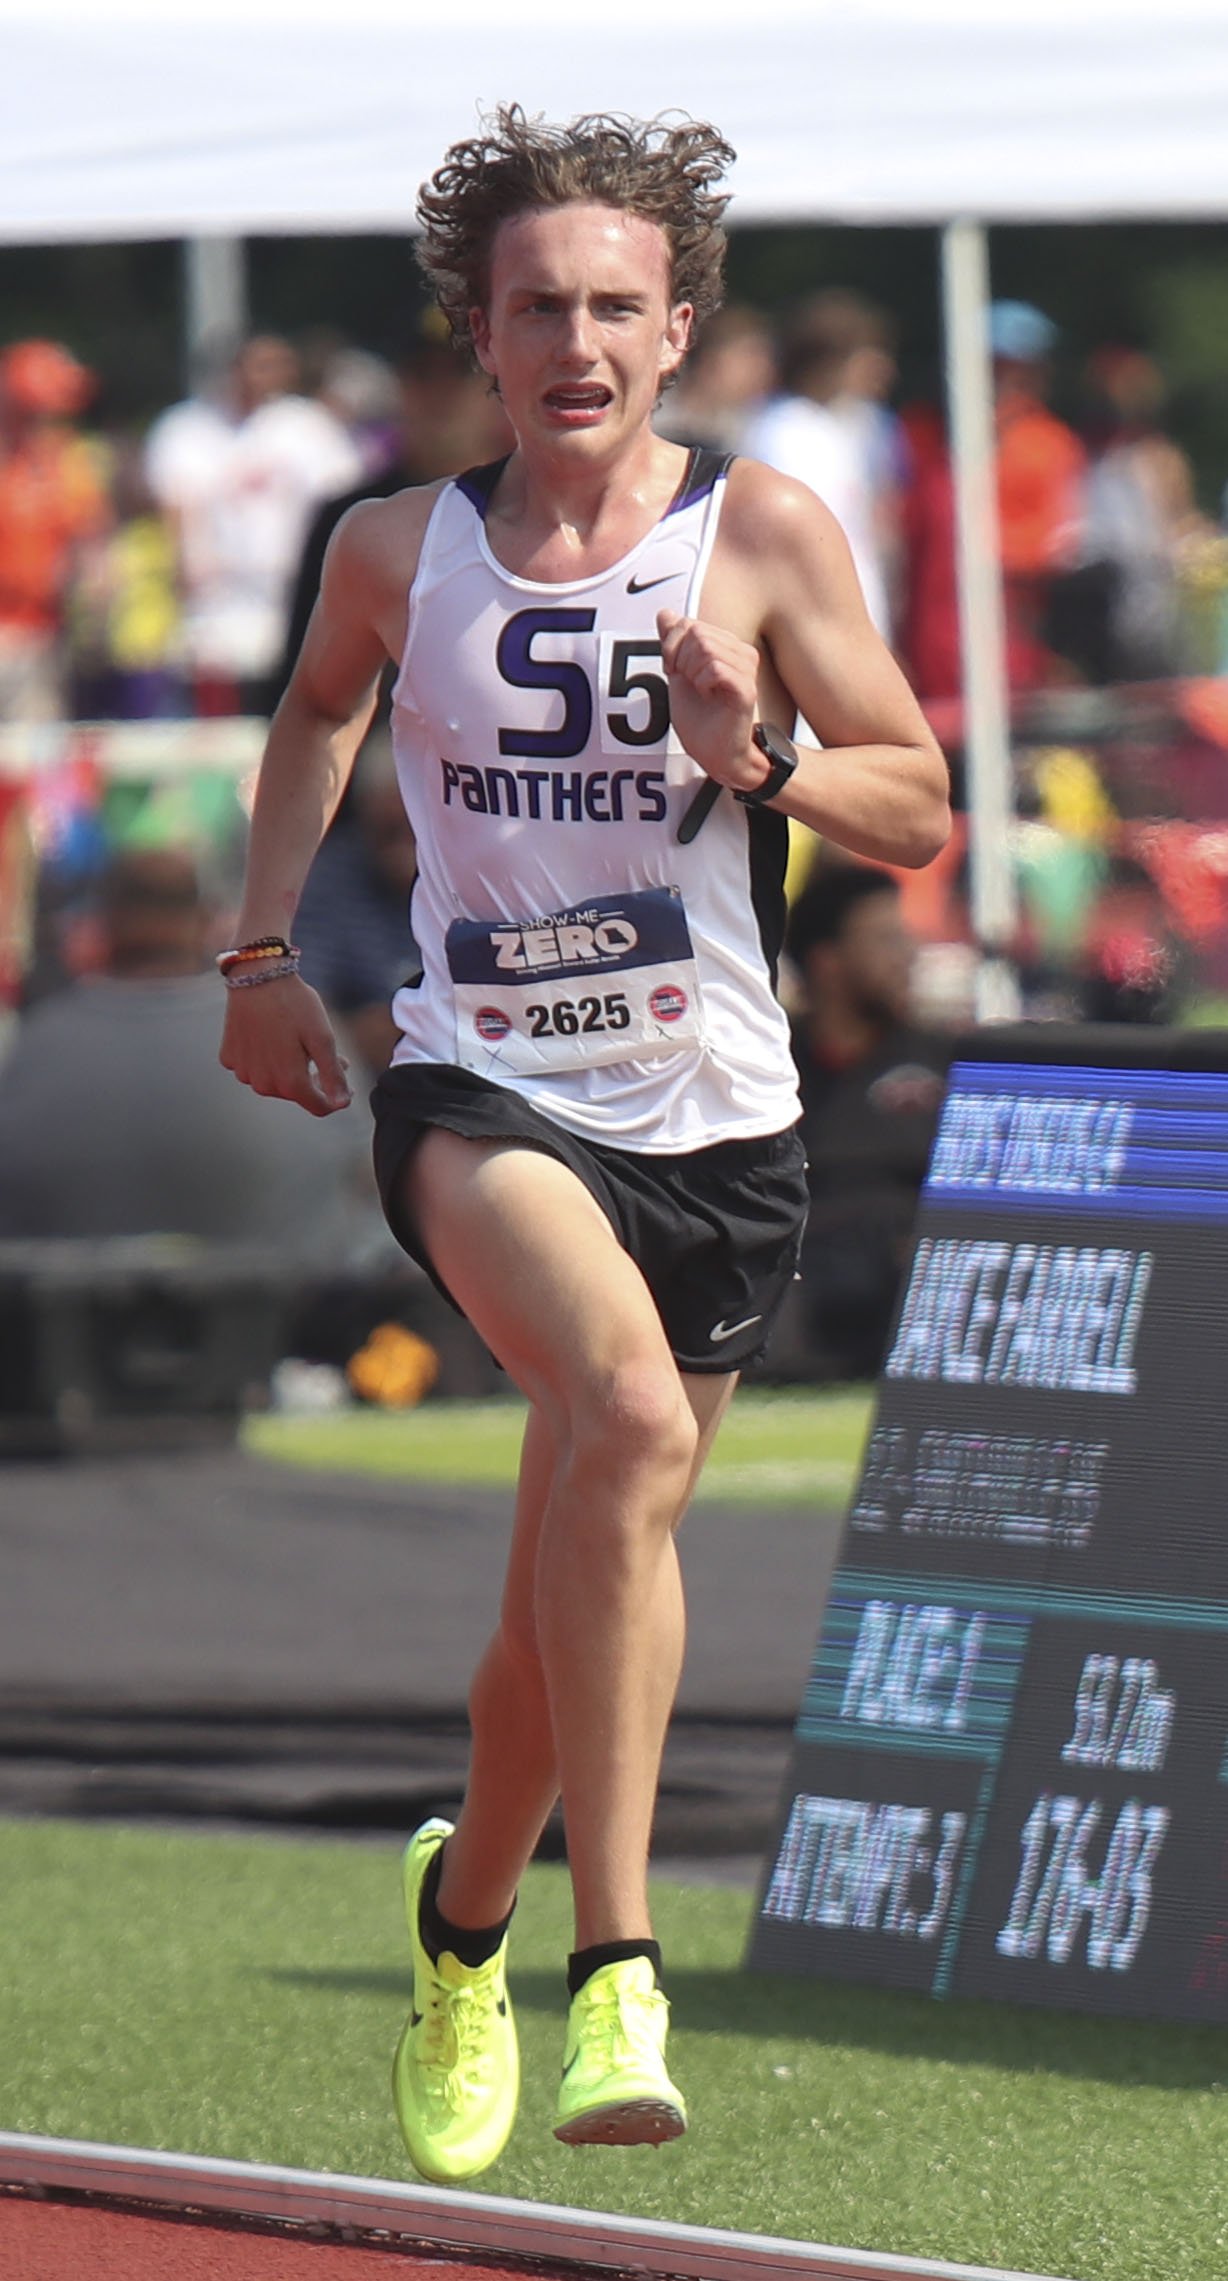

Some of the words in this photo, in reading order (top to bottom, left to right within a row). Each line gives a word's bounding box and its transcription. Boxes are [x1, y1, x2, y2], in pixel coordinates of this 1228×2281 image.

[496, 607, 598, 758] S
[607, 640, 671, 746] 5
[489, 918, 639, 969] ZERO
[519, 908, 600, 931] SHOW-ME
[525, 992, 631, 1038] 2625
